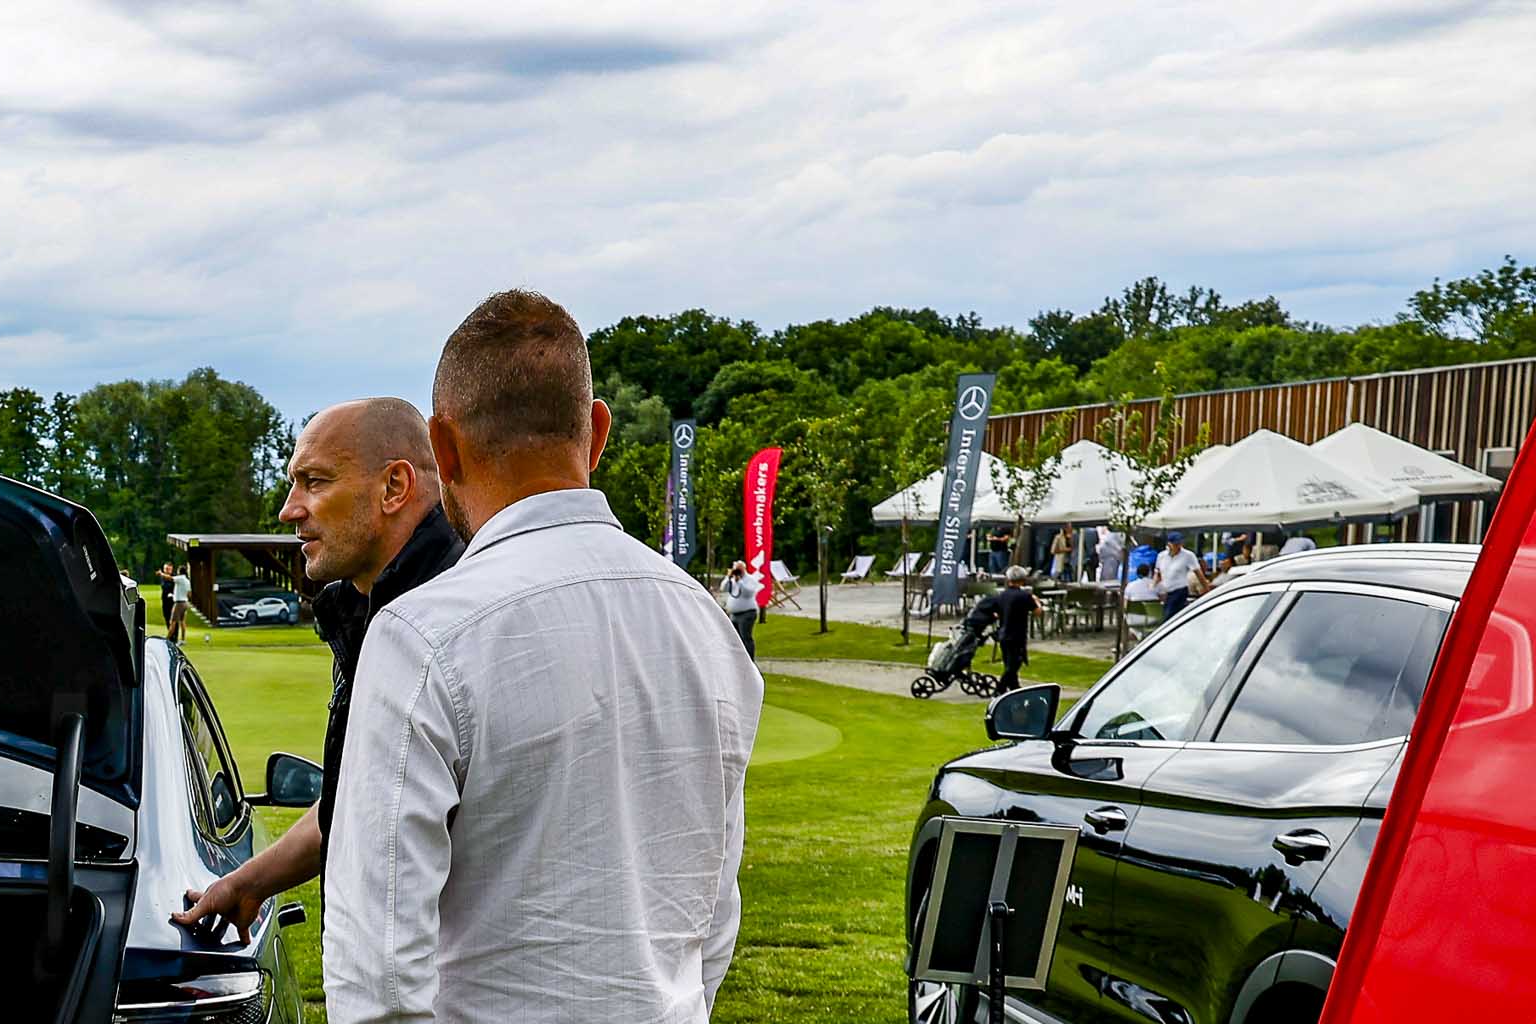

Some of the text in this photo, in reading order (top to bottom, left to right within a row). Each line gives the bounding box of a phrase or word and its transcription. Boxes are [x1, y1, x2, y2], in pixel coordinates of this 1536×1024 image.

[752, 462, 769, 548] webmakers
[940, 428, 977, 575] Inter-Car Silesia
[1065, 884, 1084, 907] M-i
